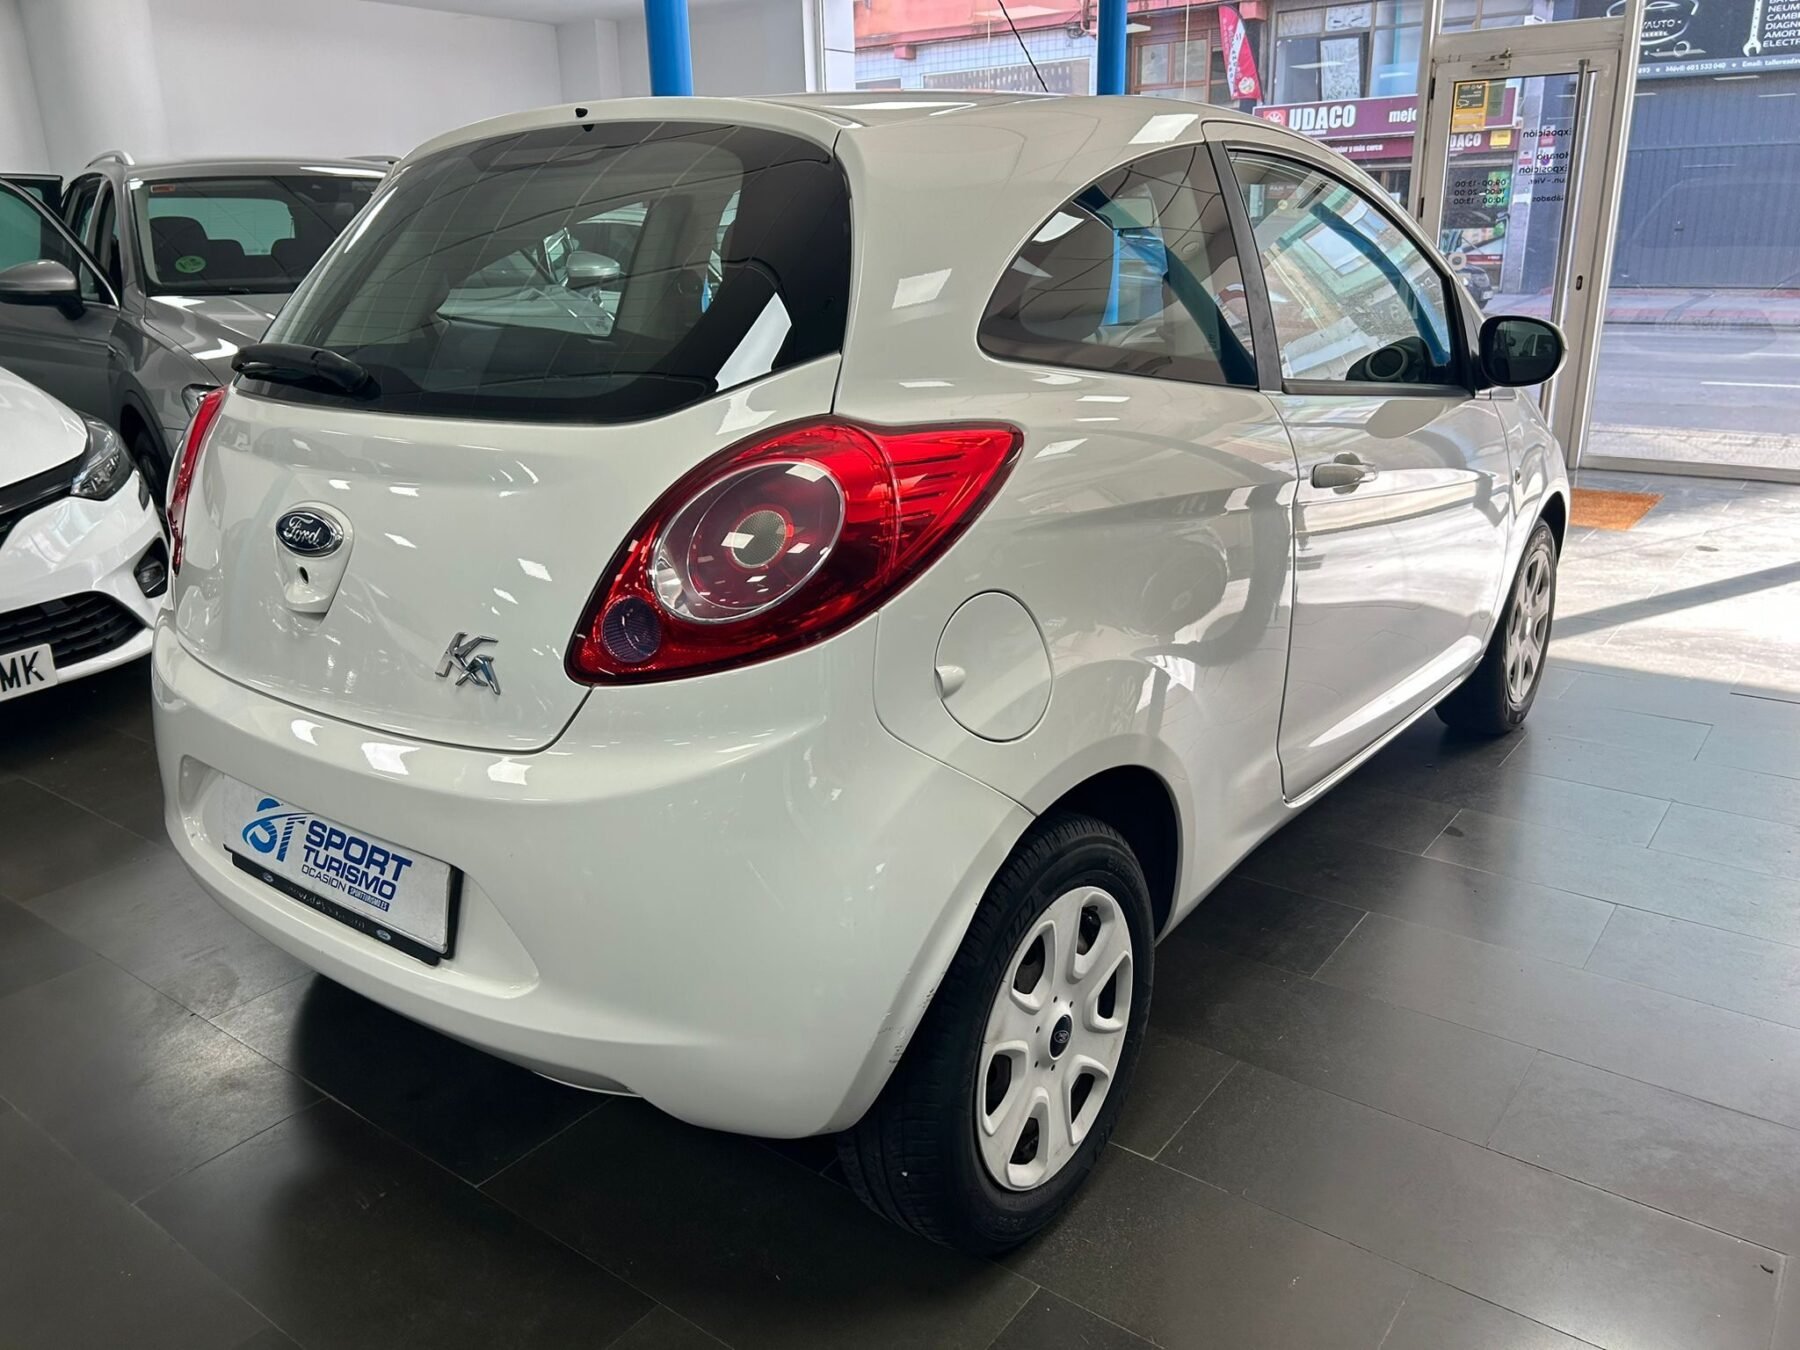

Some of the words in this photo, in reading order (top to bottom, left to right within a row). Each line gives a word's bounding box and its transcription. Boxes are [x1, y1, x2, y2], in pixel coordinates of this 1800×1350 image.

[1288, 104, 1356, 131] UDACO
[284, 516, 322, 546] Ford
[305, 819, 413, 881] SPORT
[301, 864, 348, 892] OCASION
[303, 844, 397, 900] TURISMO
